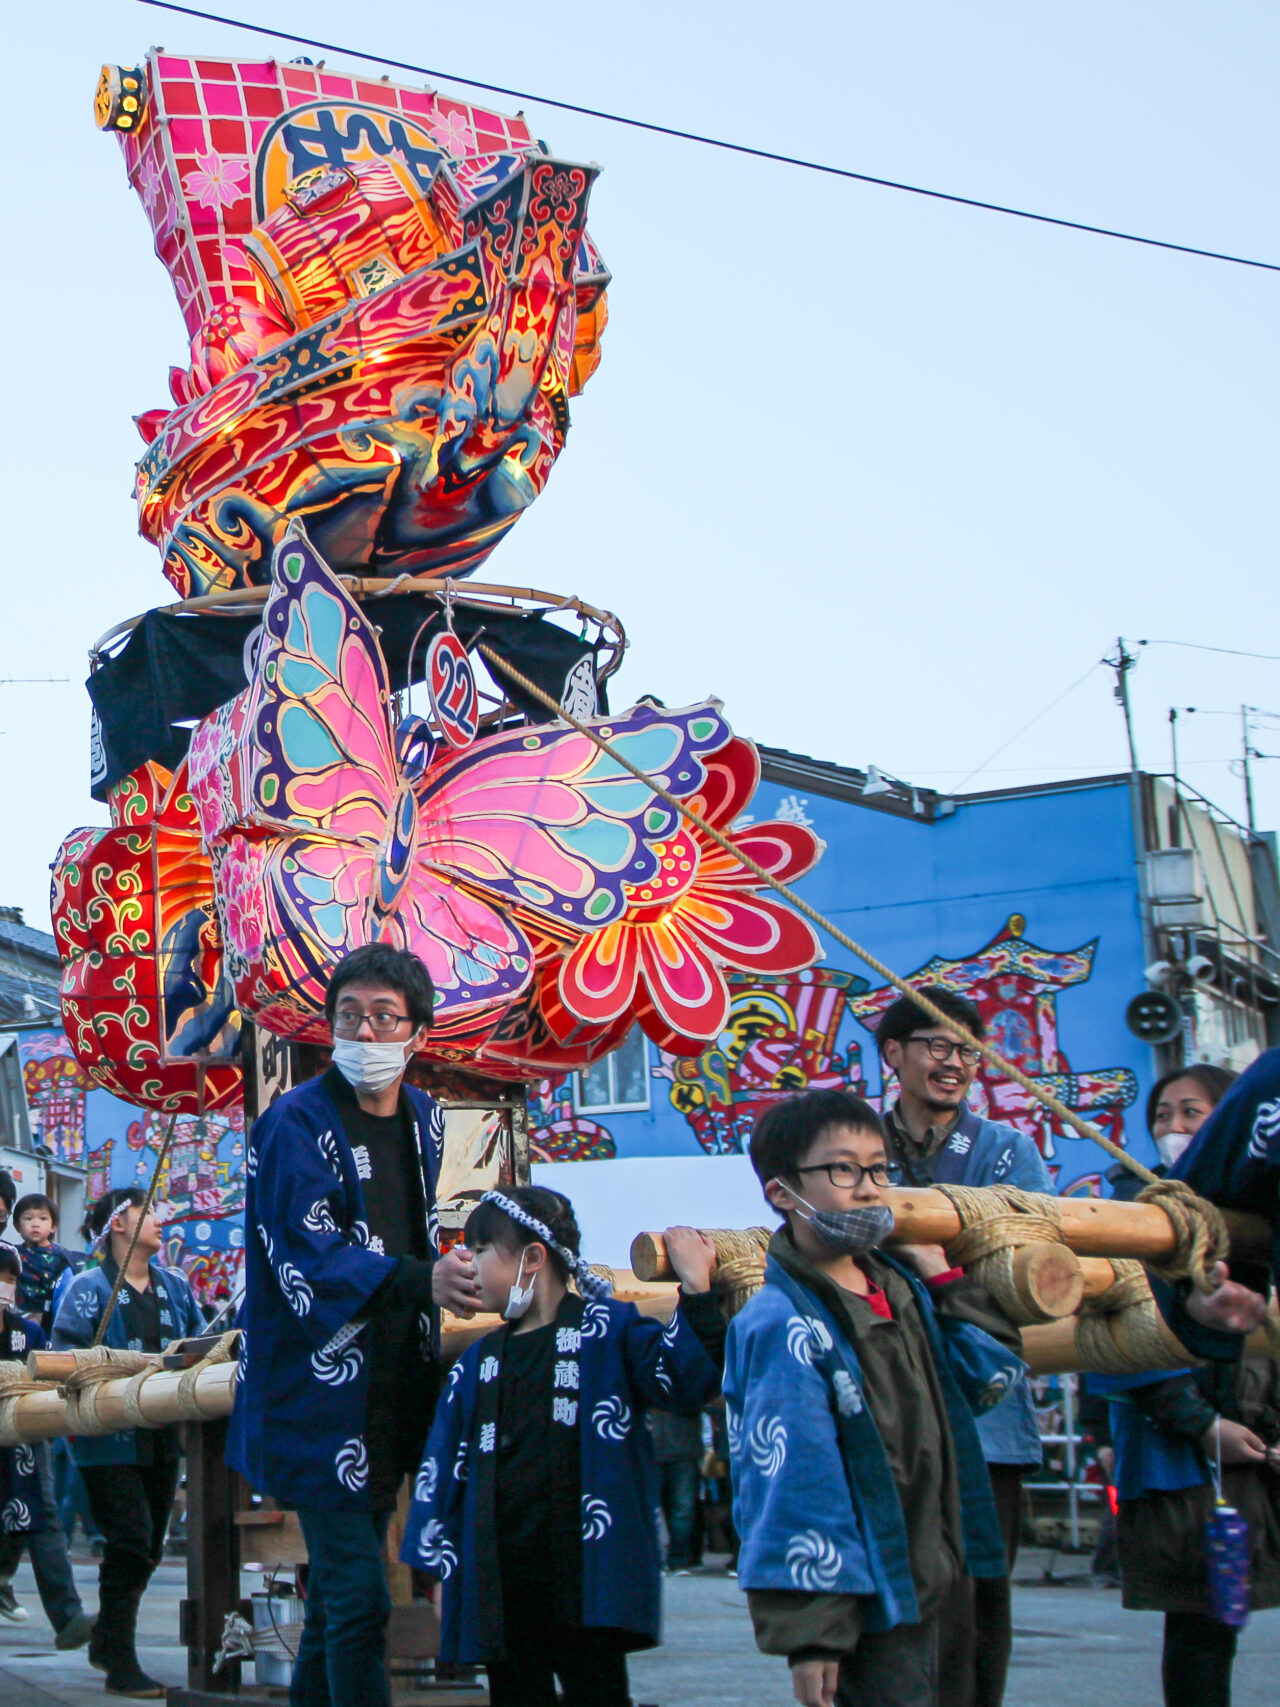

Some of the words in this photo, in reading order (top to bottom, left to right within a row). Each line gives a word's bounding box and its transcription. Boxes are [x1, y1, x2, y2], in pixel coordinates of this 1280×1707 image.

[437, 647, 475, 736] 22
[479, 1355, 499, 1453] 小若
[552, 1327, 582, 1426] 御蔵町
